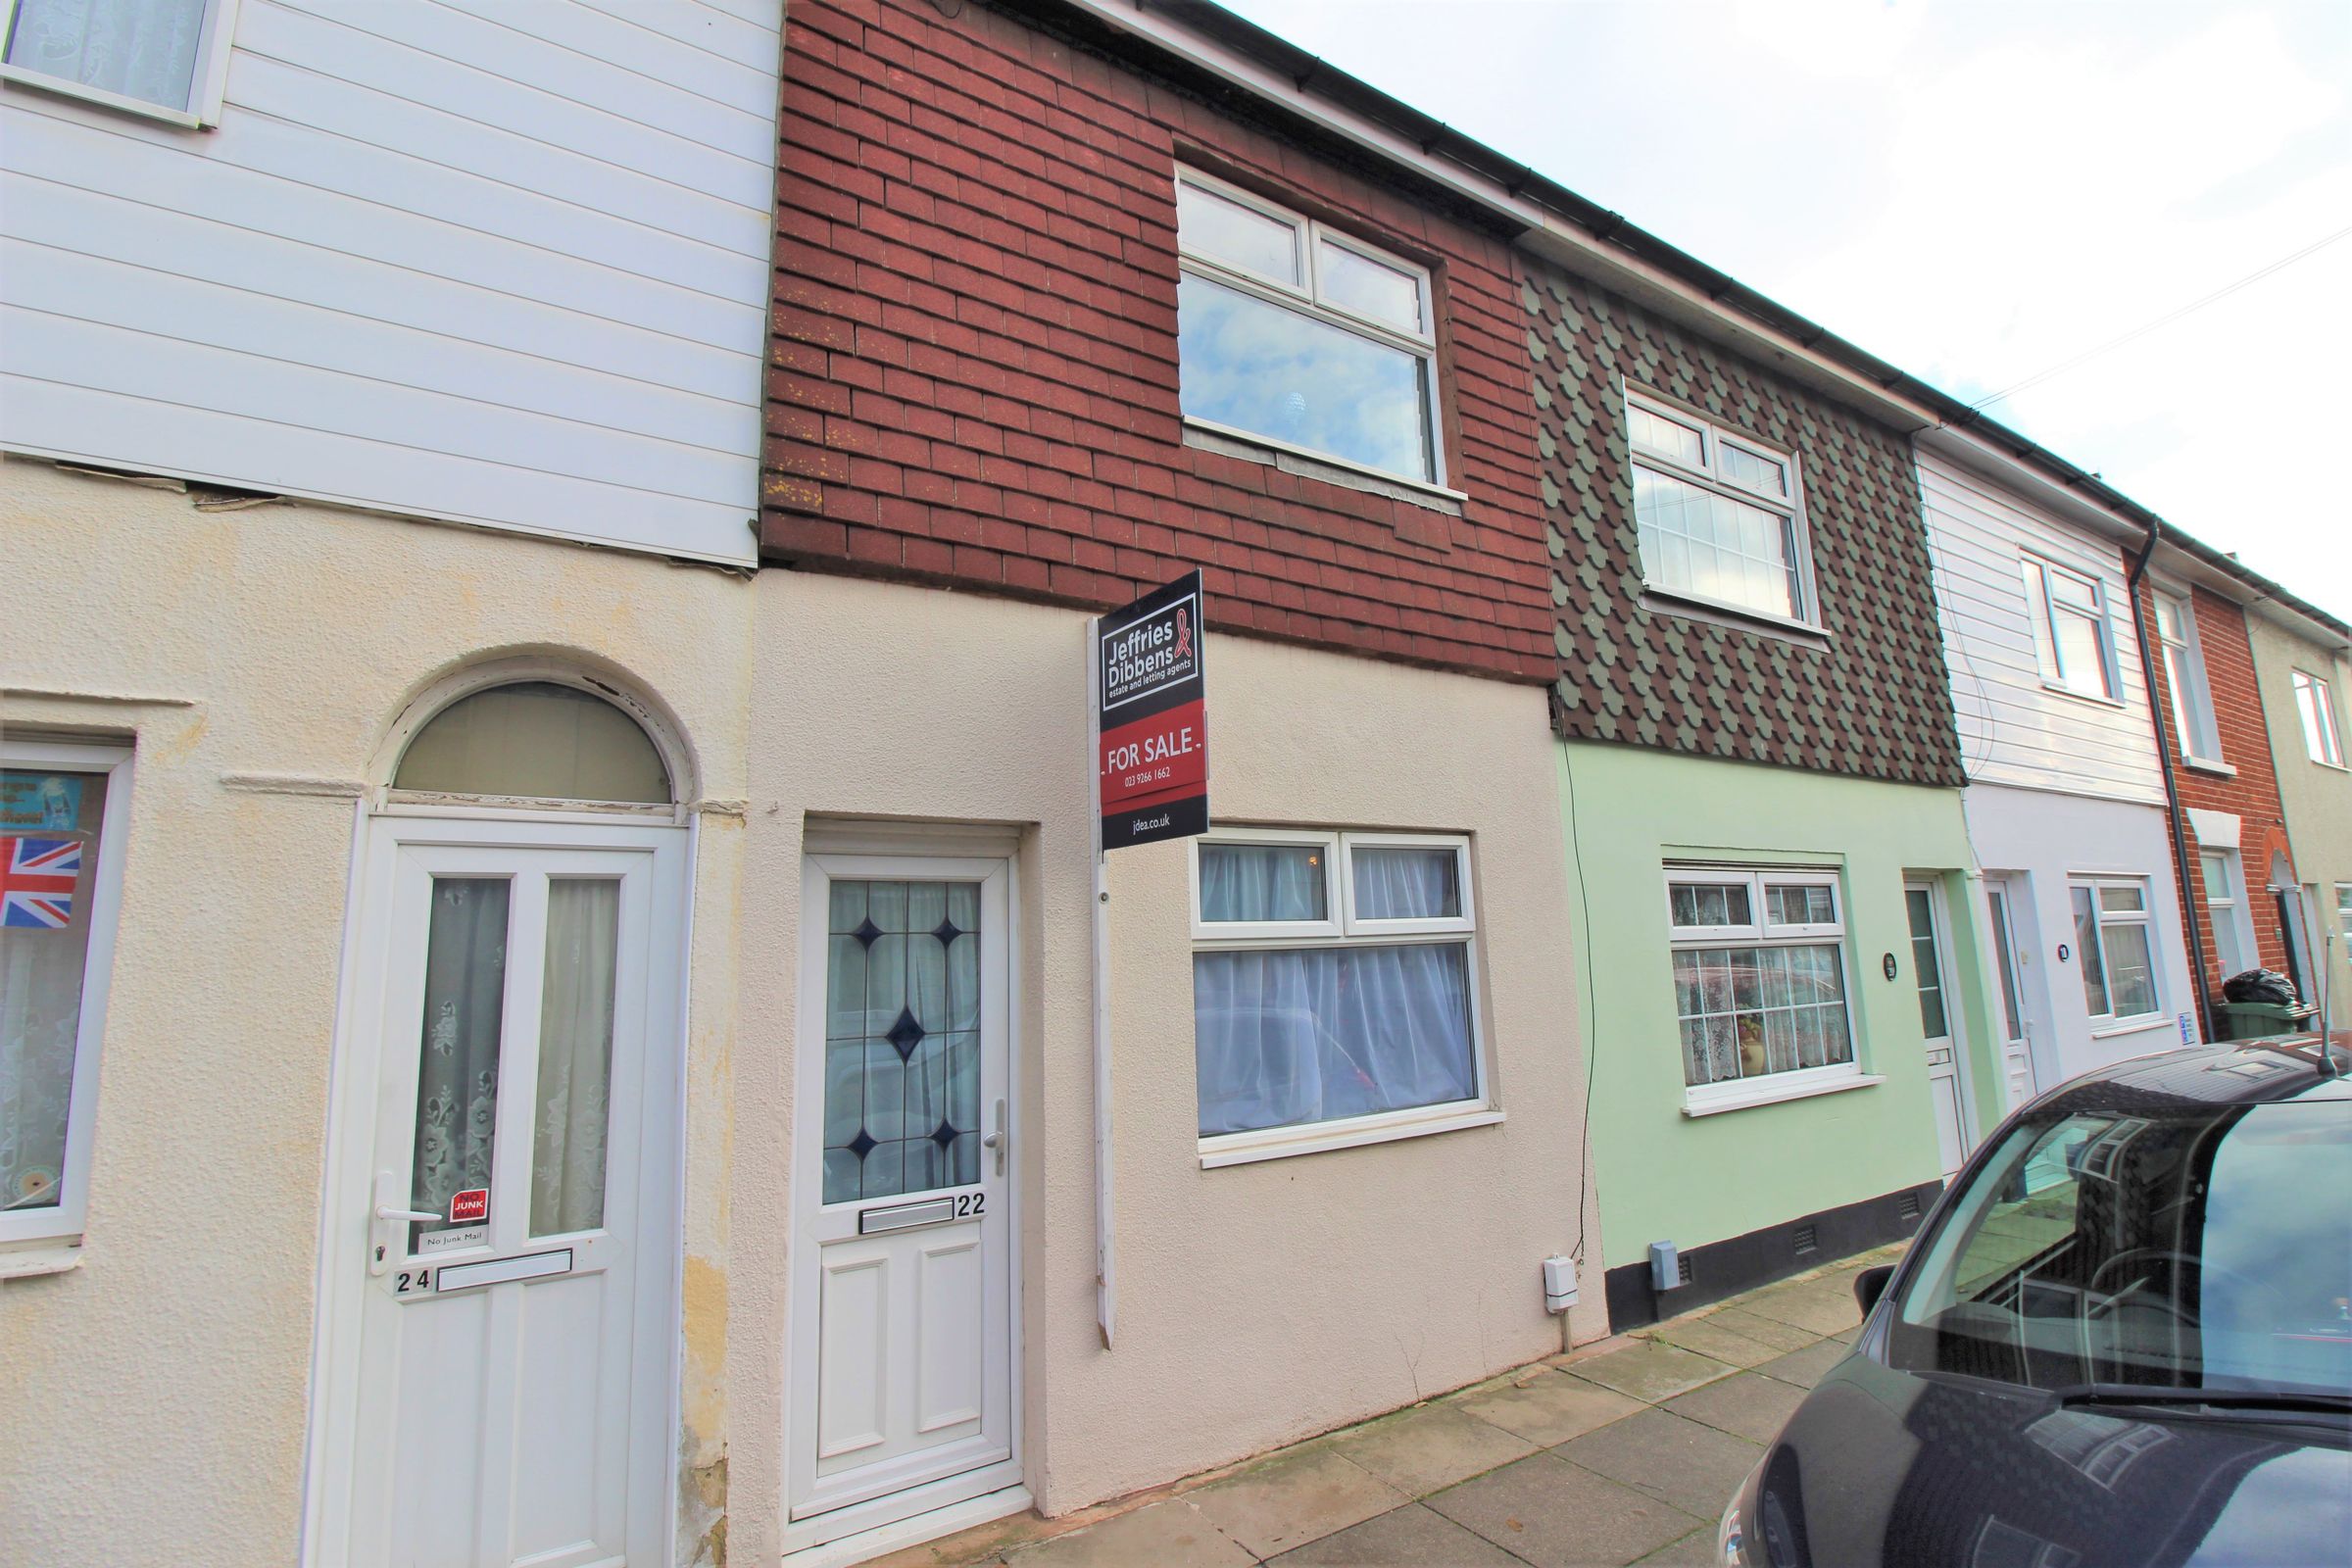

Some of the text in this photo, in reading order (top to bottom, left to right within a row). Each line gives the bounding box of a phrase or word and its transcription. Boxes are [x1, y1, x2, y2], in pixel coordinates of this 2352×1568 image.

[1108, 621, 1173, 665] Jeffries
[1108, 646, 1174, 688] Dibbens
[1108, 660, 1192, 698] estate and letting agents
[1107, 726, 1193, 774] FOR SALE
[1124, 766, 1171, 787] 023 9266 1662
[1133, 813, 1170, 835] jdea.co.uk
[455, 1200, 484, 1210] JUNK
[460, 1193, 479, 1201] NO
[957, 1193, 986, 1217] 22
[443, 1235, 462, 1246] Junk
[397, 1270, 430, 1293] 24
